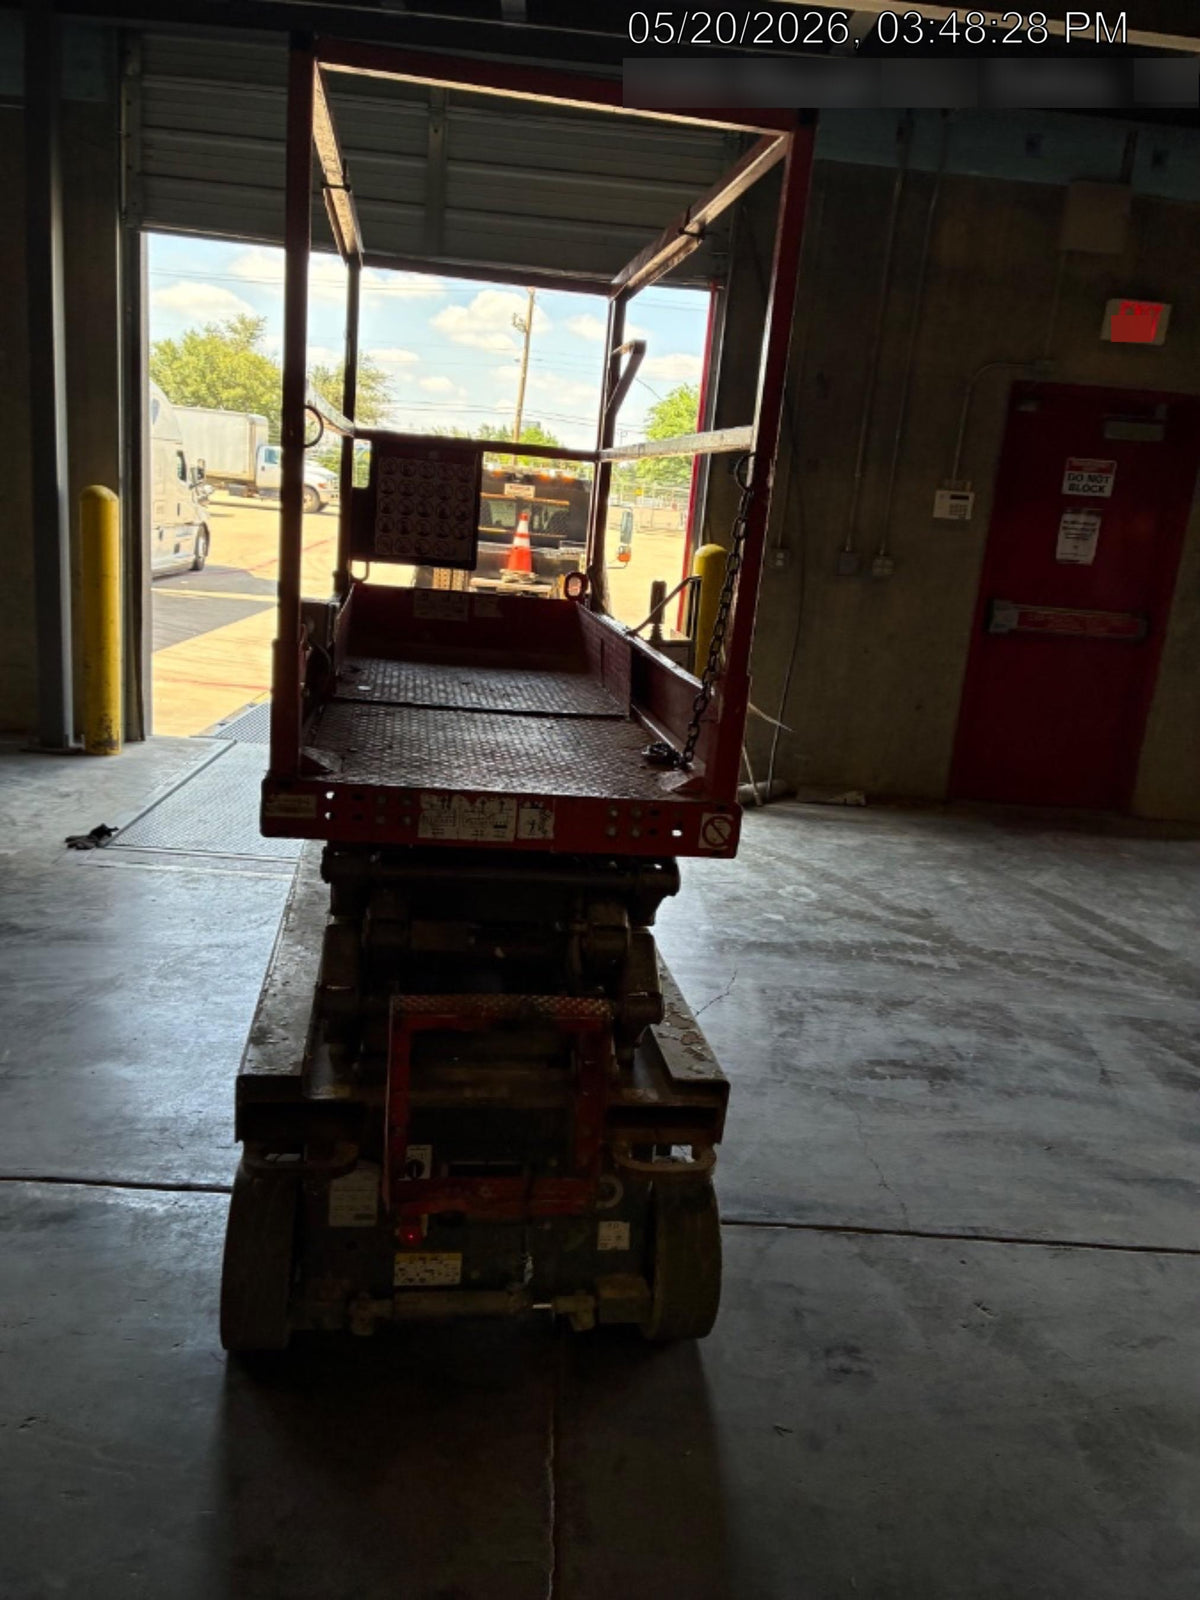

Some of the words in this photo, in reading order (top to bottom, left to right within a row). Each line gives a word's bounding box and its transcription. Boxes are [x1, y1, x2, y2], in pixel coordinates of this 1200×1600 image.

[1067, 473, 1084, 482] DO
[1088, 475, 1111, 484] NOT
[1068, 483, 1106, 494] BLOCK
